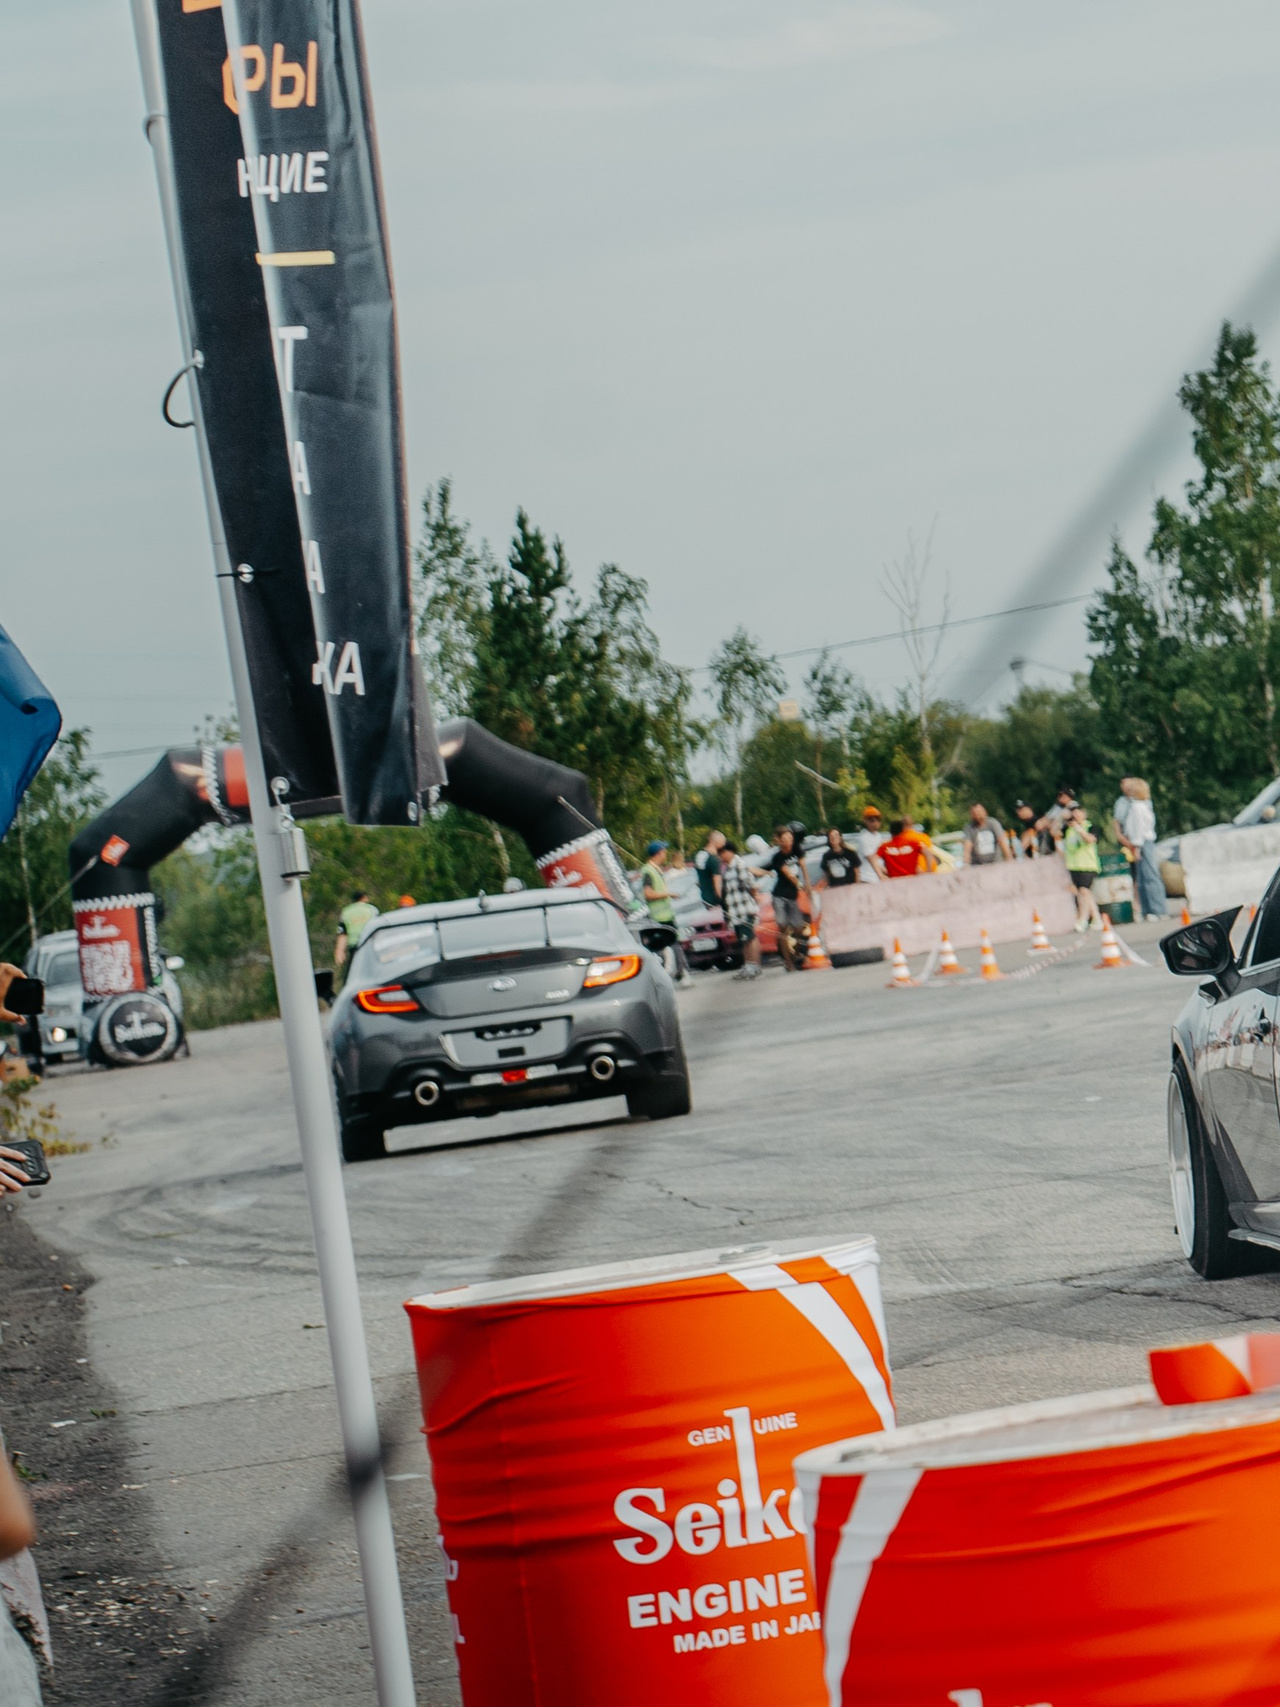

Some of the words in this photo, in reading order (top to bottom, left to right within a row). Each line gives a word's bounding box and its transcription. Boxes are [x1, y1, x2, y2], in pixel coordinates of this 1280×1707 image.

[627, 1568, 808, 1629] ENGINE
[672, 1624, 747, 1654] MADE
[752, 1618, 780, 1641] IN
